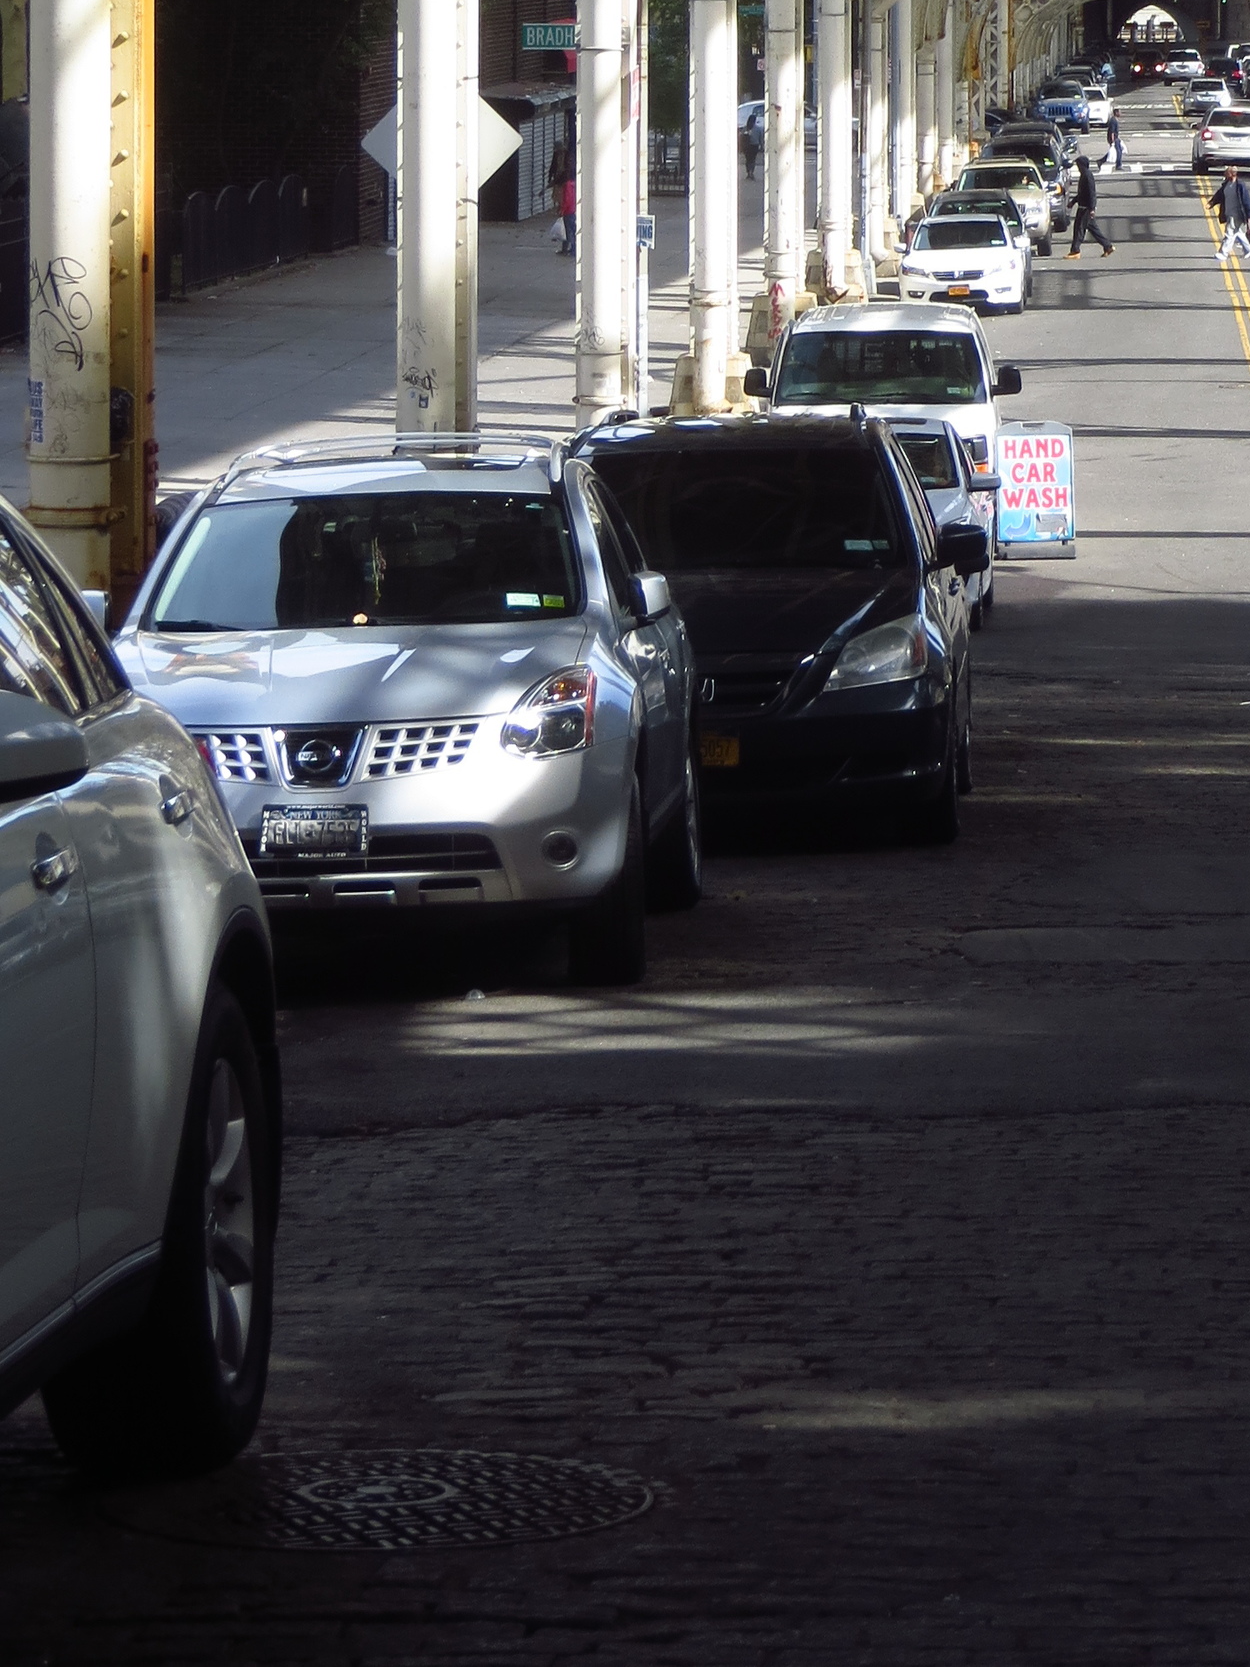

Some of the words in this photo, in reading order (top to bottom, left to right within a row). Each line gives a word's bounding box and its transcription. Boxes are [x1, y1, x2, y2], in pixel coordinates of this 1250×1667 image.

[1003, 438, 1064, 459] HAND
[1011, 462, 1057, 484] CAR
[1002, 486, 1068, 508] WASH
[290, 810, 313, 820] NEW
[316, 810, 342, 820] YORK
